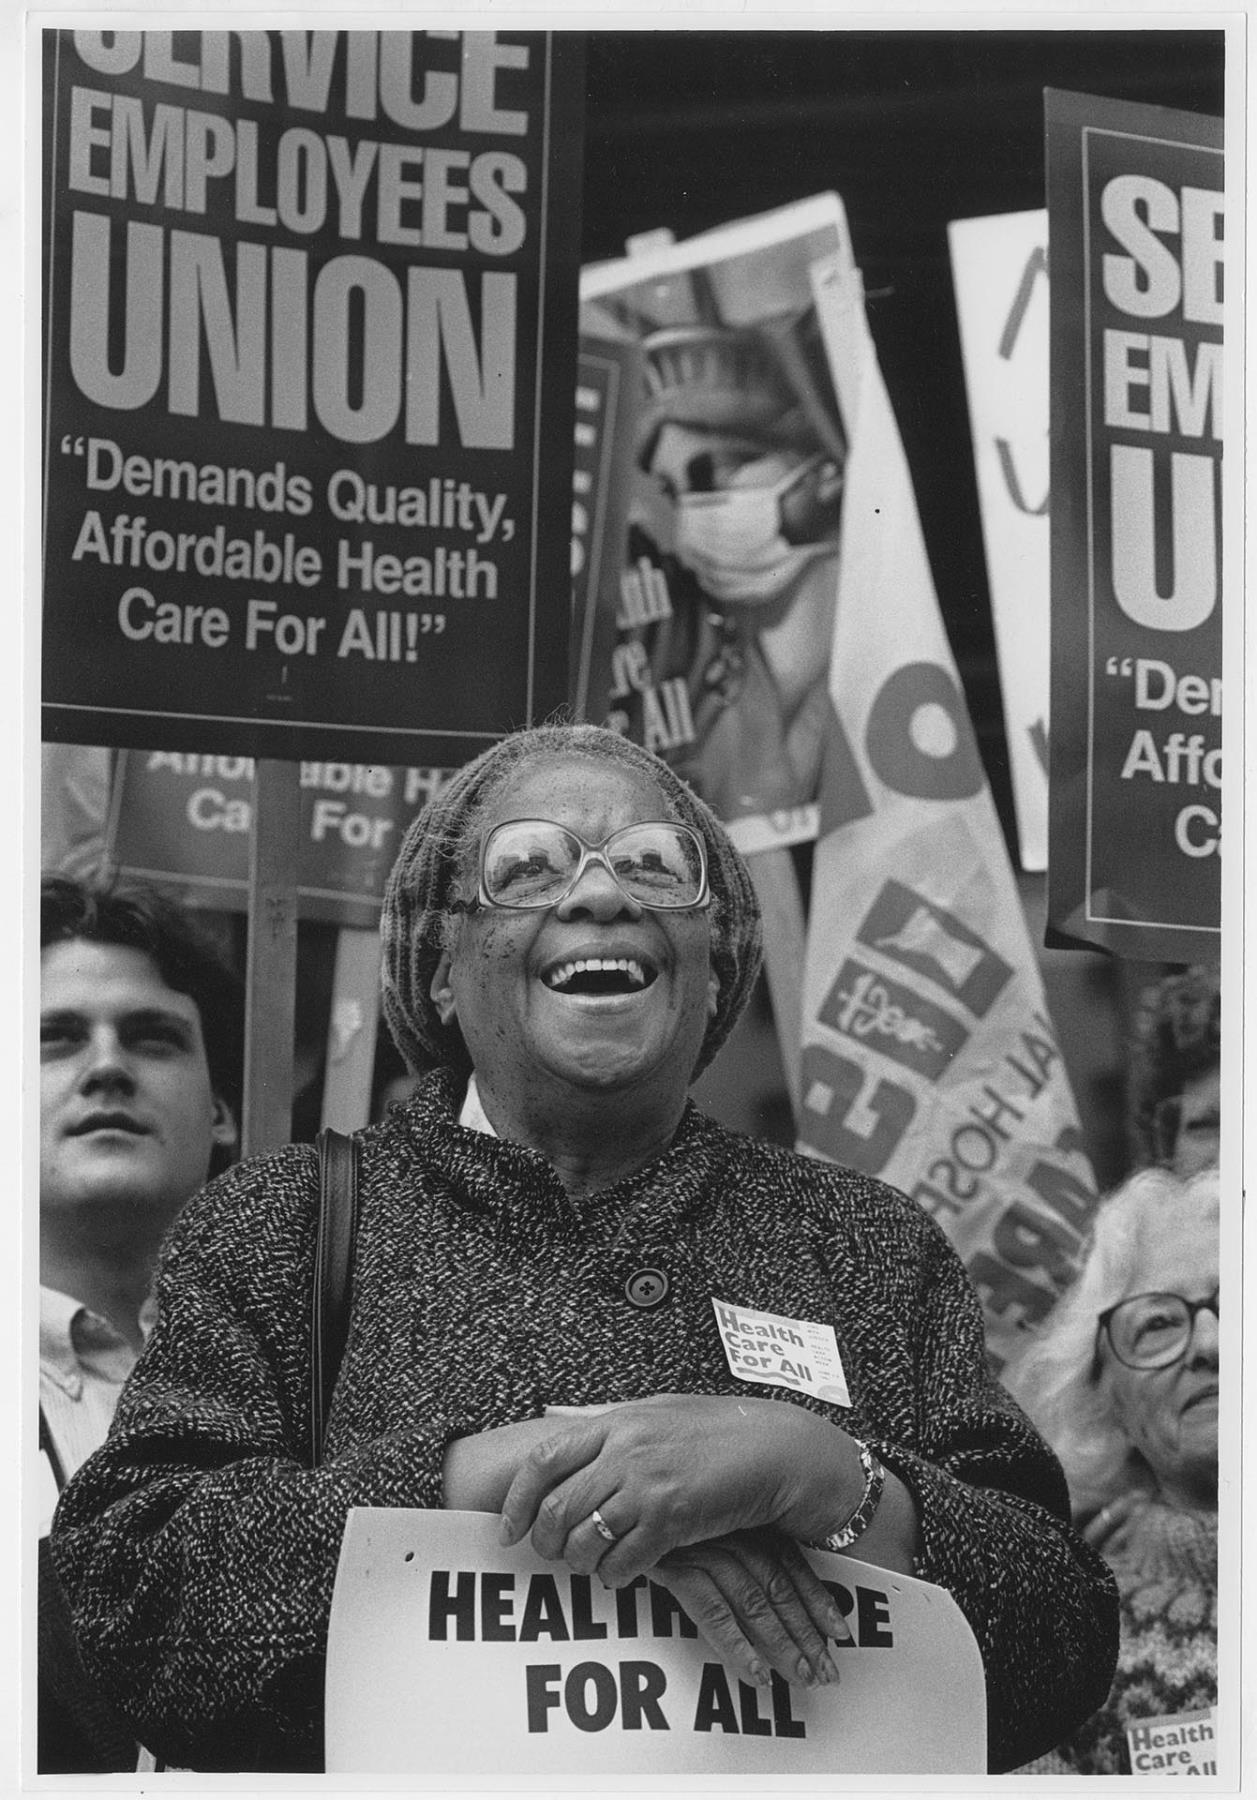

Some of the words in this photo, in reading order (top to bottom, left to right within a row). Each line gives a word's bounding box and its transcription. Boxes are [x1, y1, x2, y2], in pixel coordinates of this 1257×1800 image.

[74, 31, 529, 136] VICE
[69, 85, 527, 256] EMPLOYEES
[69, 209, 517, 450] UNION
[328, 469, 515, 543] Quality,
[72, 510, 322, 587] Affordable
[337, 539, 498, 599] Health
[118, 587, 230, 648] Care
[246, 600, 326, 655] For
[1105, 657, 1222, 716] “De
[311, 800, 394, 849] For
[1175, 804, 1221, 858] C
[718, 1306, 804, 1348] Health
[725, 1331, 785, 1356] Care
[729, 1347, 772, 1368] For
[780, 1359, 812, 1382] All
[526, 1661, 670, 1733] FOR
[694, 1662, 806, 1738] ALL
[1132, 1724, 1214, 1751] Health
[1136, 1750, 1191, 1771] Care
